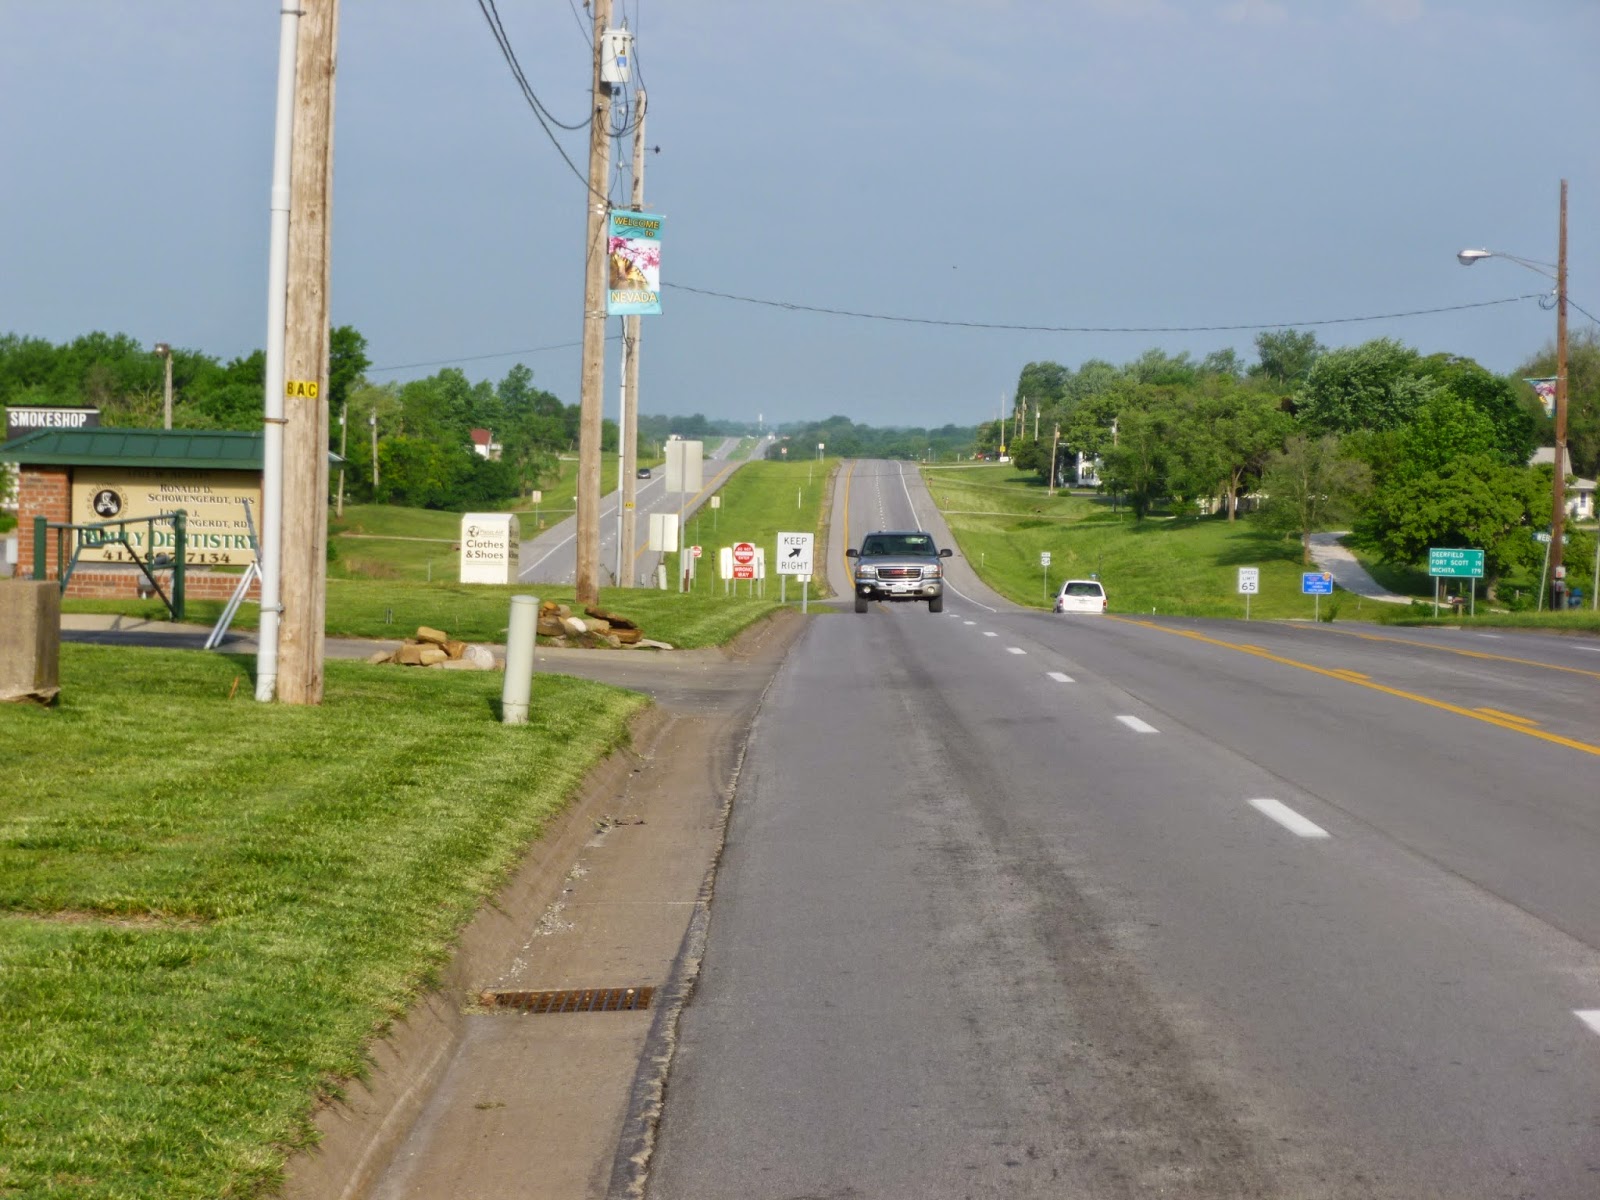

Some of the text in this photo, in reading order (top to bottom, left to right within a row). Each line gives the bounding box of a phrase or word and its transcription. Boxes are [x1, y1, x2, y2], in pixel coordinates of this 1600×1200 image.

[613, 216, 660, 229] WELCOME
[645, 230, 655, 238] to
[611, 291, 658, 303] NEVADA
[10, 411, 87, 427] SMOKESHOP
[160, 484, 200, 494] RONALD
[233, 520, 253, 529] RD
[151, 531, 258, 549] DETISTRY
[466, 540, 504, 549] Clothes
[784, 537, 808, 545] KEEP
[466, 550, 504, 559] & Shoes
[781, 561, 808, 570] RIGHT
[1241, 582, 1256, 590] 65
